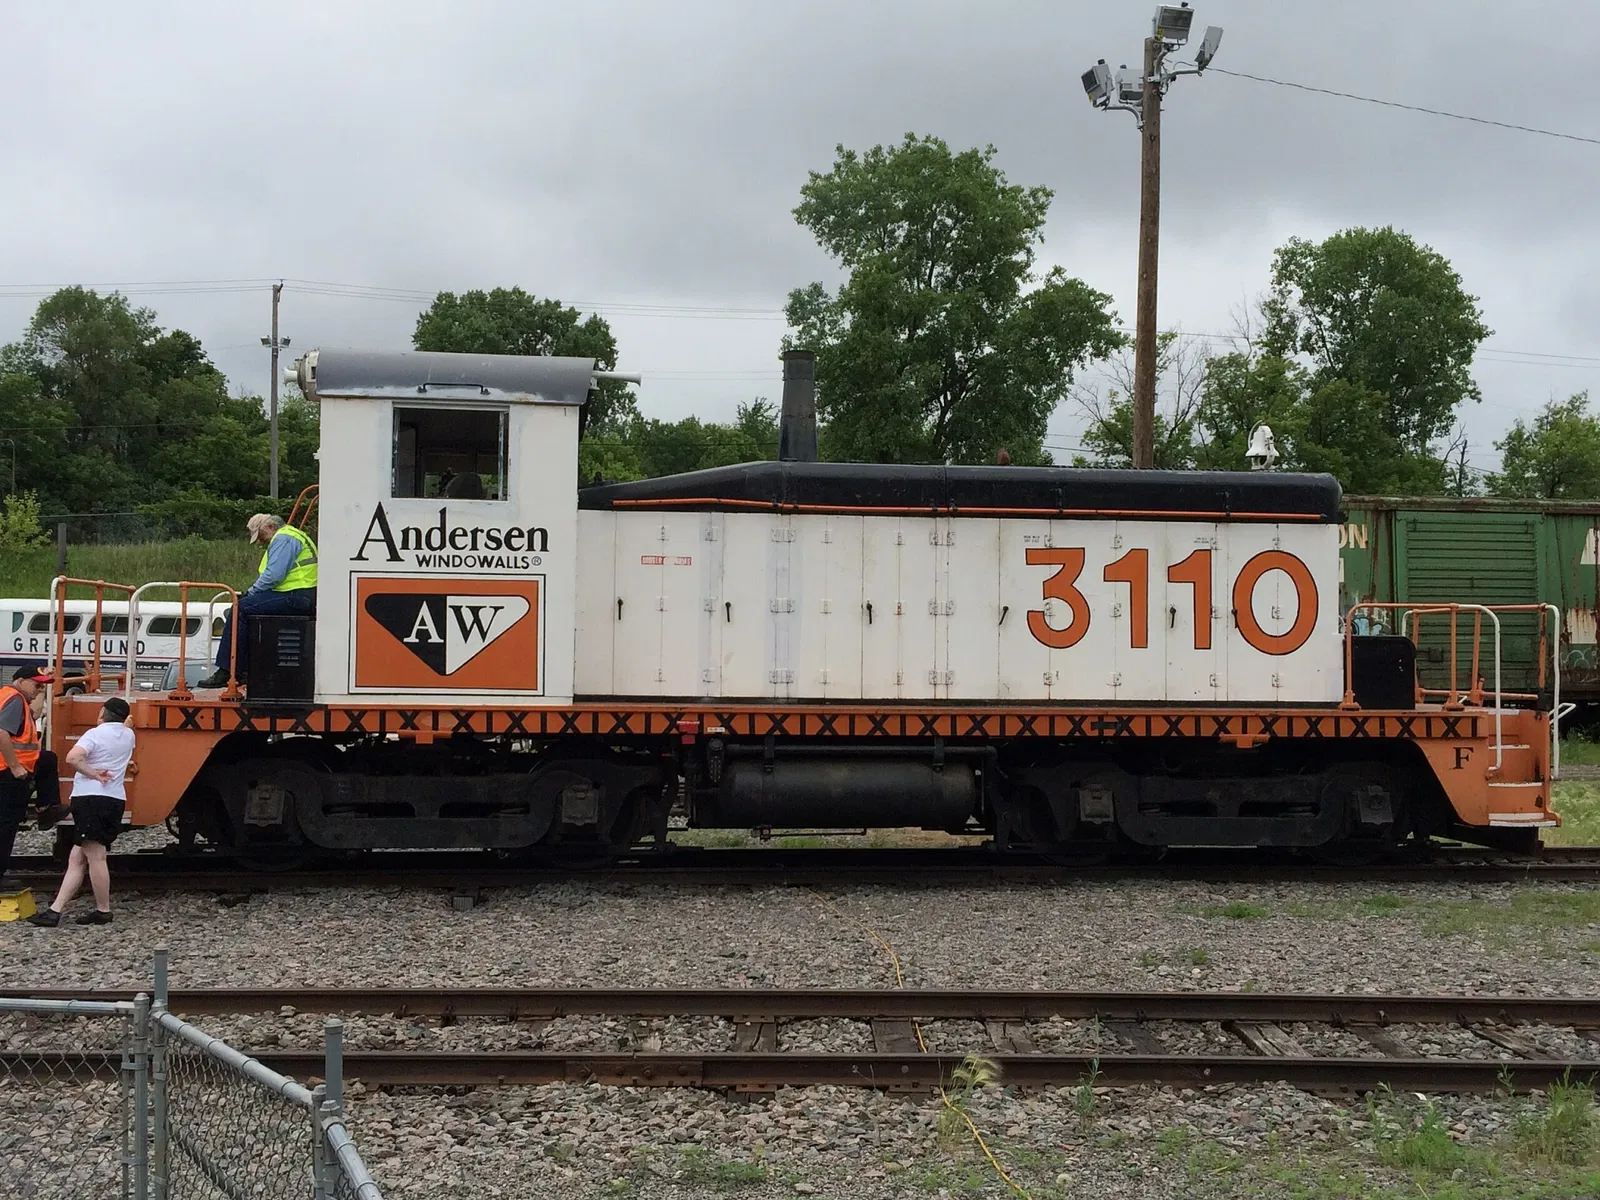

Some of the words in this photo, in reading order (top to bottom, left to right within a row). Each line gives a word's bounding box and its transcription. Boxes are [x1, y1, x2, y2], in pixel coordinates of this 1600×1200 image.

[350, 501, 549, 562] Andersen
[403, 600, 505, 644] AW
[1025, 547, 1319, 656] 3110
[1452, 746, 1474, 770] F
